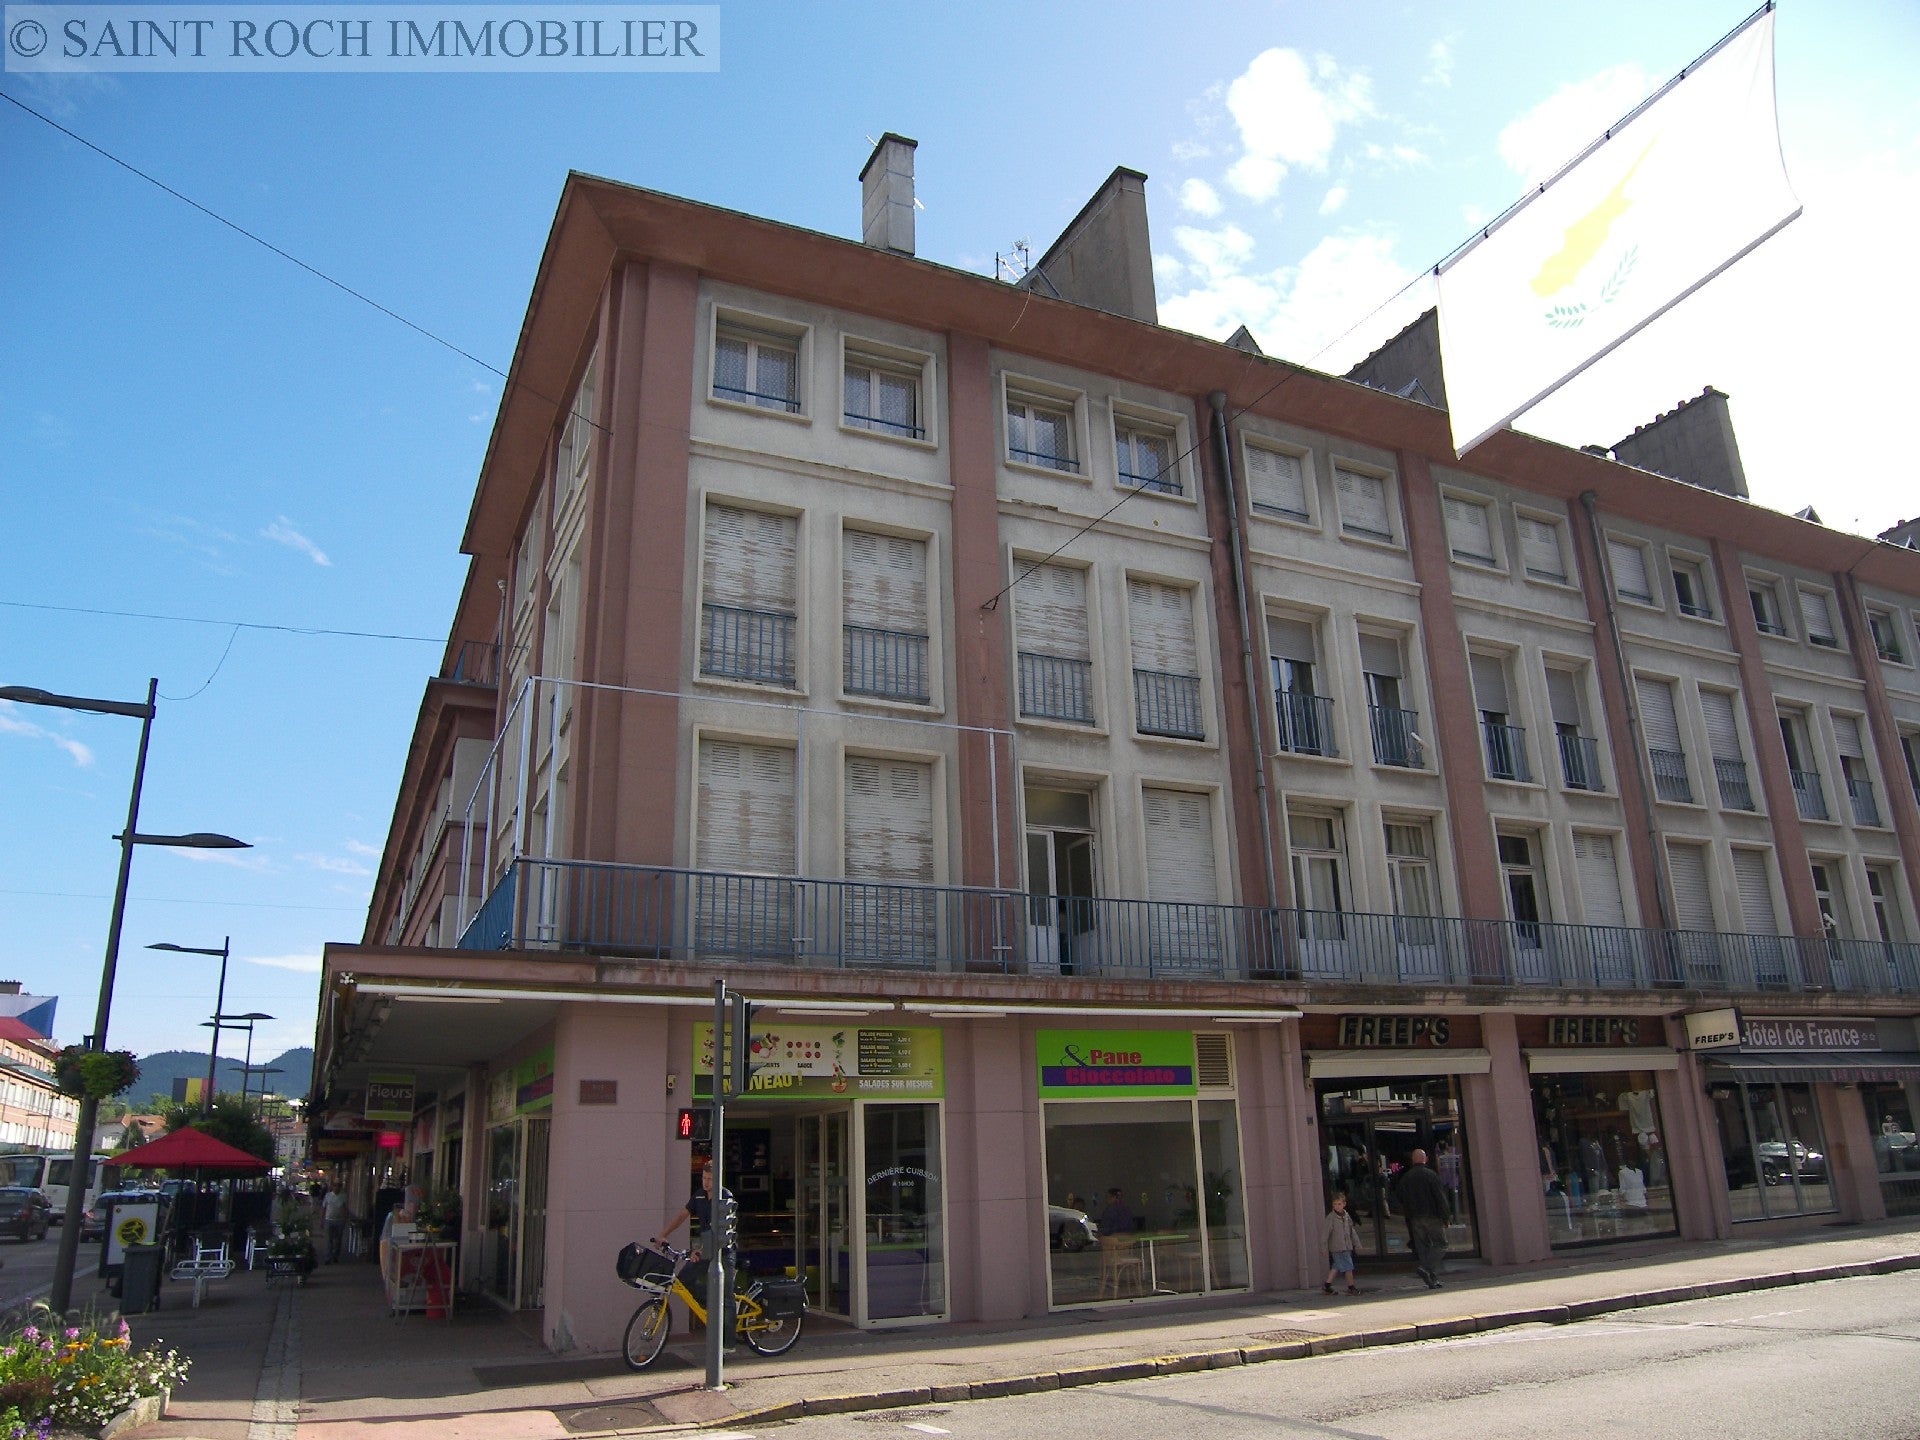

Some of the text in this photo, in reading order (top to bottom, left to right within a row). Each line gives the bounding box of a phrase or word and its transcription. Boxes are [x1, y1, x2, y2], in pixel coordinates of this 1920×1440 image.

[1340, 1016, 1449, 1046] FREEP'S
[1550, 1017, 1639, 1044] FREEP'S
[1695, 1032, 1734, 1045] FREEP'S
[1785, 1022, 1805, 1046] de
[1806, 1022, 1860, 1046] France
[1060, 1044, 1142, 1068] & Pane
[859, 1080, 934, 1089] SALADES SUR MESURE
[1065, 1067, 1176, 1084] Cioccolato
[369, 1084, 412, 1099] Fleurs
[867, 1166, 939, 1185] DERNIÈRE CUISSON
